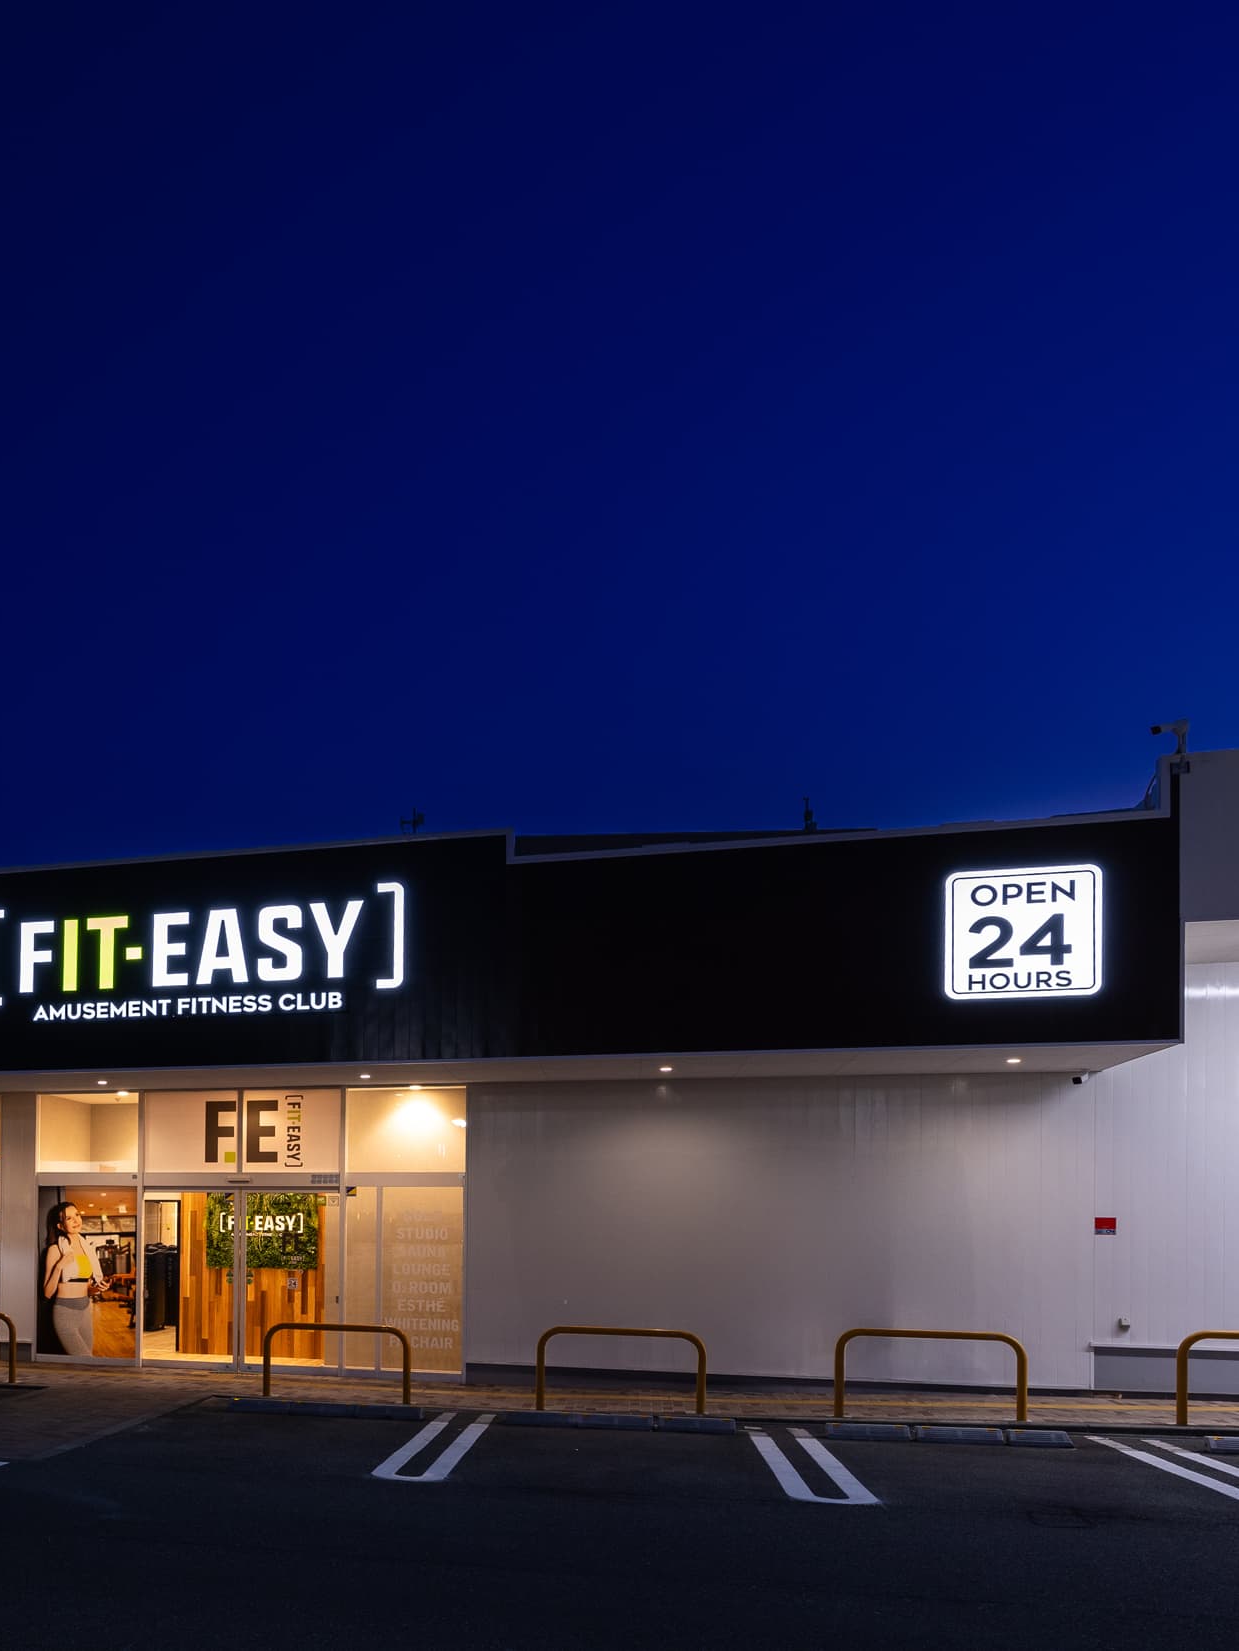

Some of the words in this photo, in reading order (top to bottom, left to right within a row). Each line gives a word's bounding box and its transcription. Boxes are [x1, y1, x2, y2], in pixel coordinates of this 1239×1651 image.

[970, 879, 1076, 907] OPEN
[968, 913, 1073, 969] 24
[968, 970, 1073, 991] HOURS
[32, 999, 171, 1021] AMUSEMENT
[177, 994, 272, 1015] FITNESS
[278, 991, 343, 1011] CLUB
[395, 1226, 448, 1240] STUDIO
[394, 1245, 447, 1257] AUNA
[393, 1263, 451, 1276] LOUNGE
[384, 1317, 459, 1332] WHITENING
